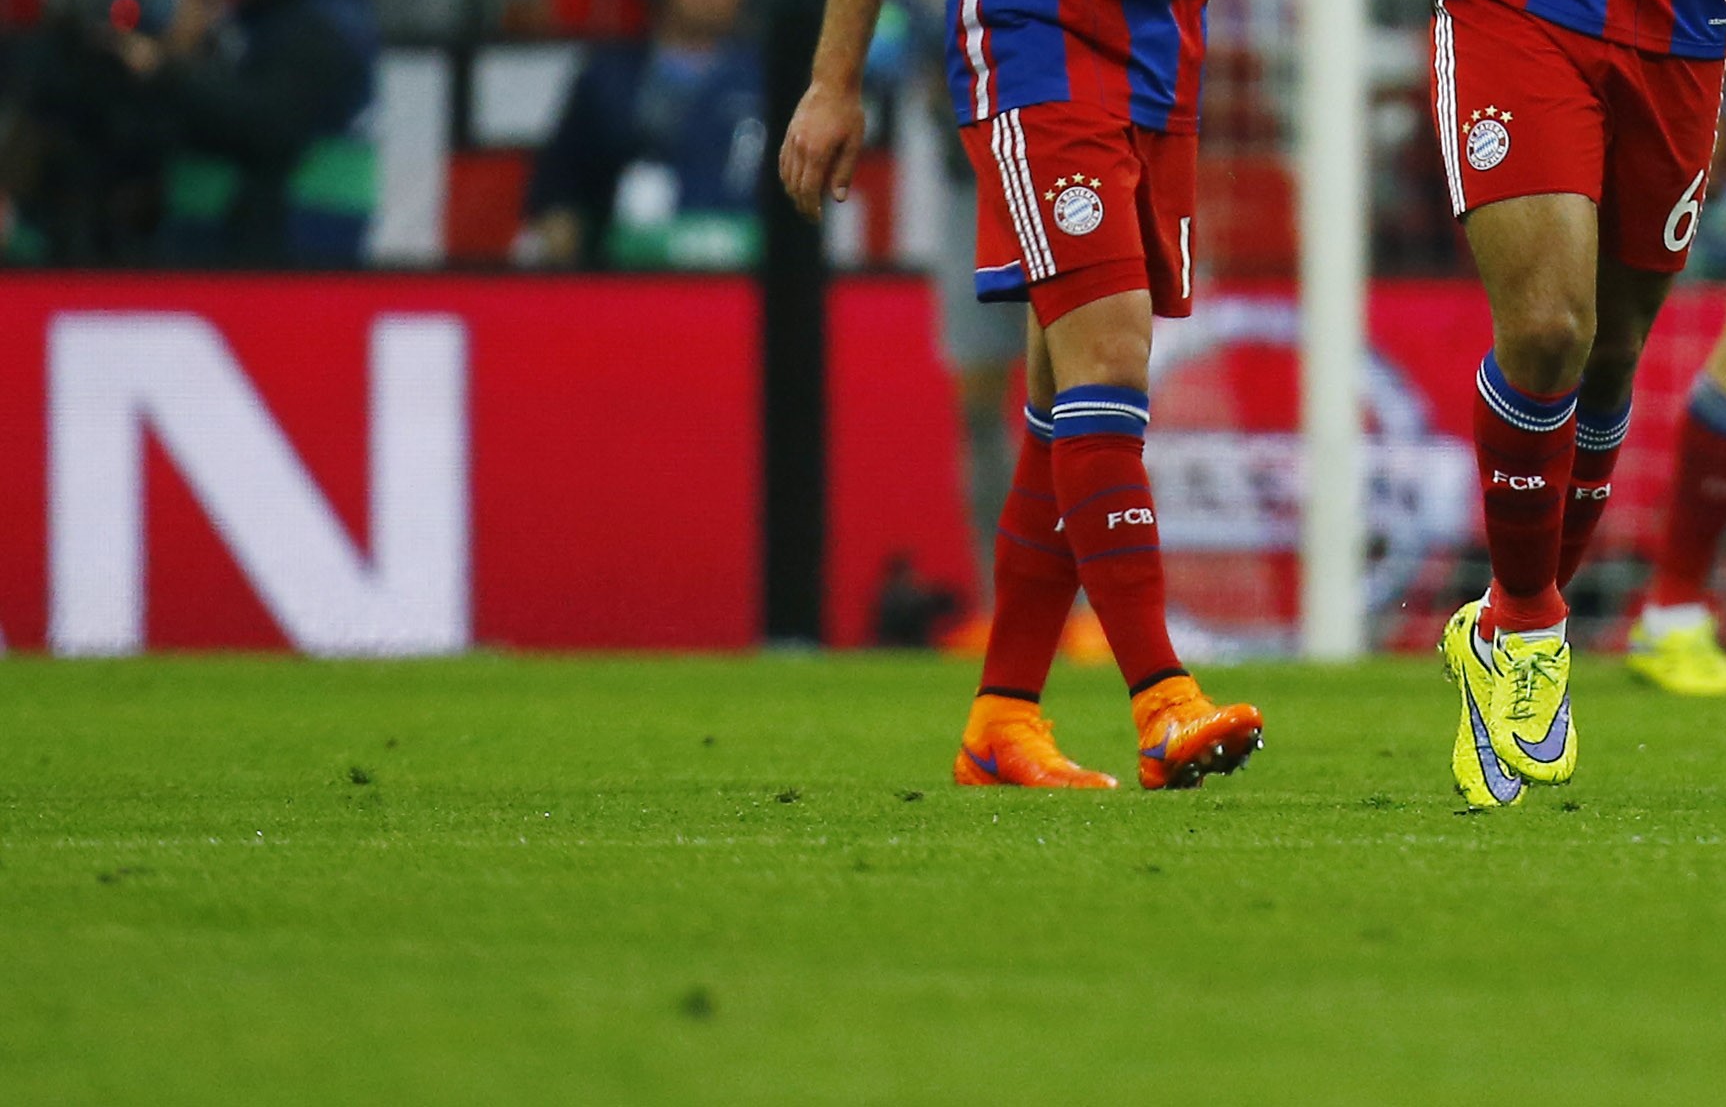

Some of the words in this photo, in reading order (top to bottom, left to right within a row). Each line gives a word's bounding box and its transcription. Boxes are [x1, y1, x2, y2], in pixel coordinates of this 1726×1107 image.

[1664, 169, 1703, 252] 6
[0, 310, 472, 657] N
[1493, 469, 1546, 490] FCB
[1107, 508, 1154, 529] FCB
